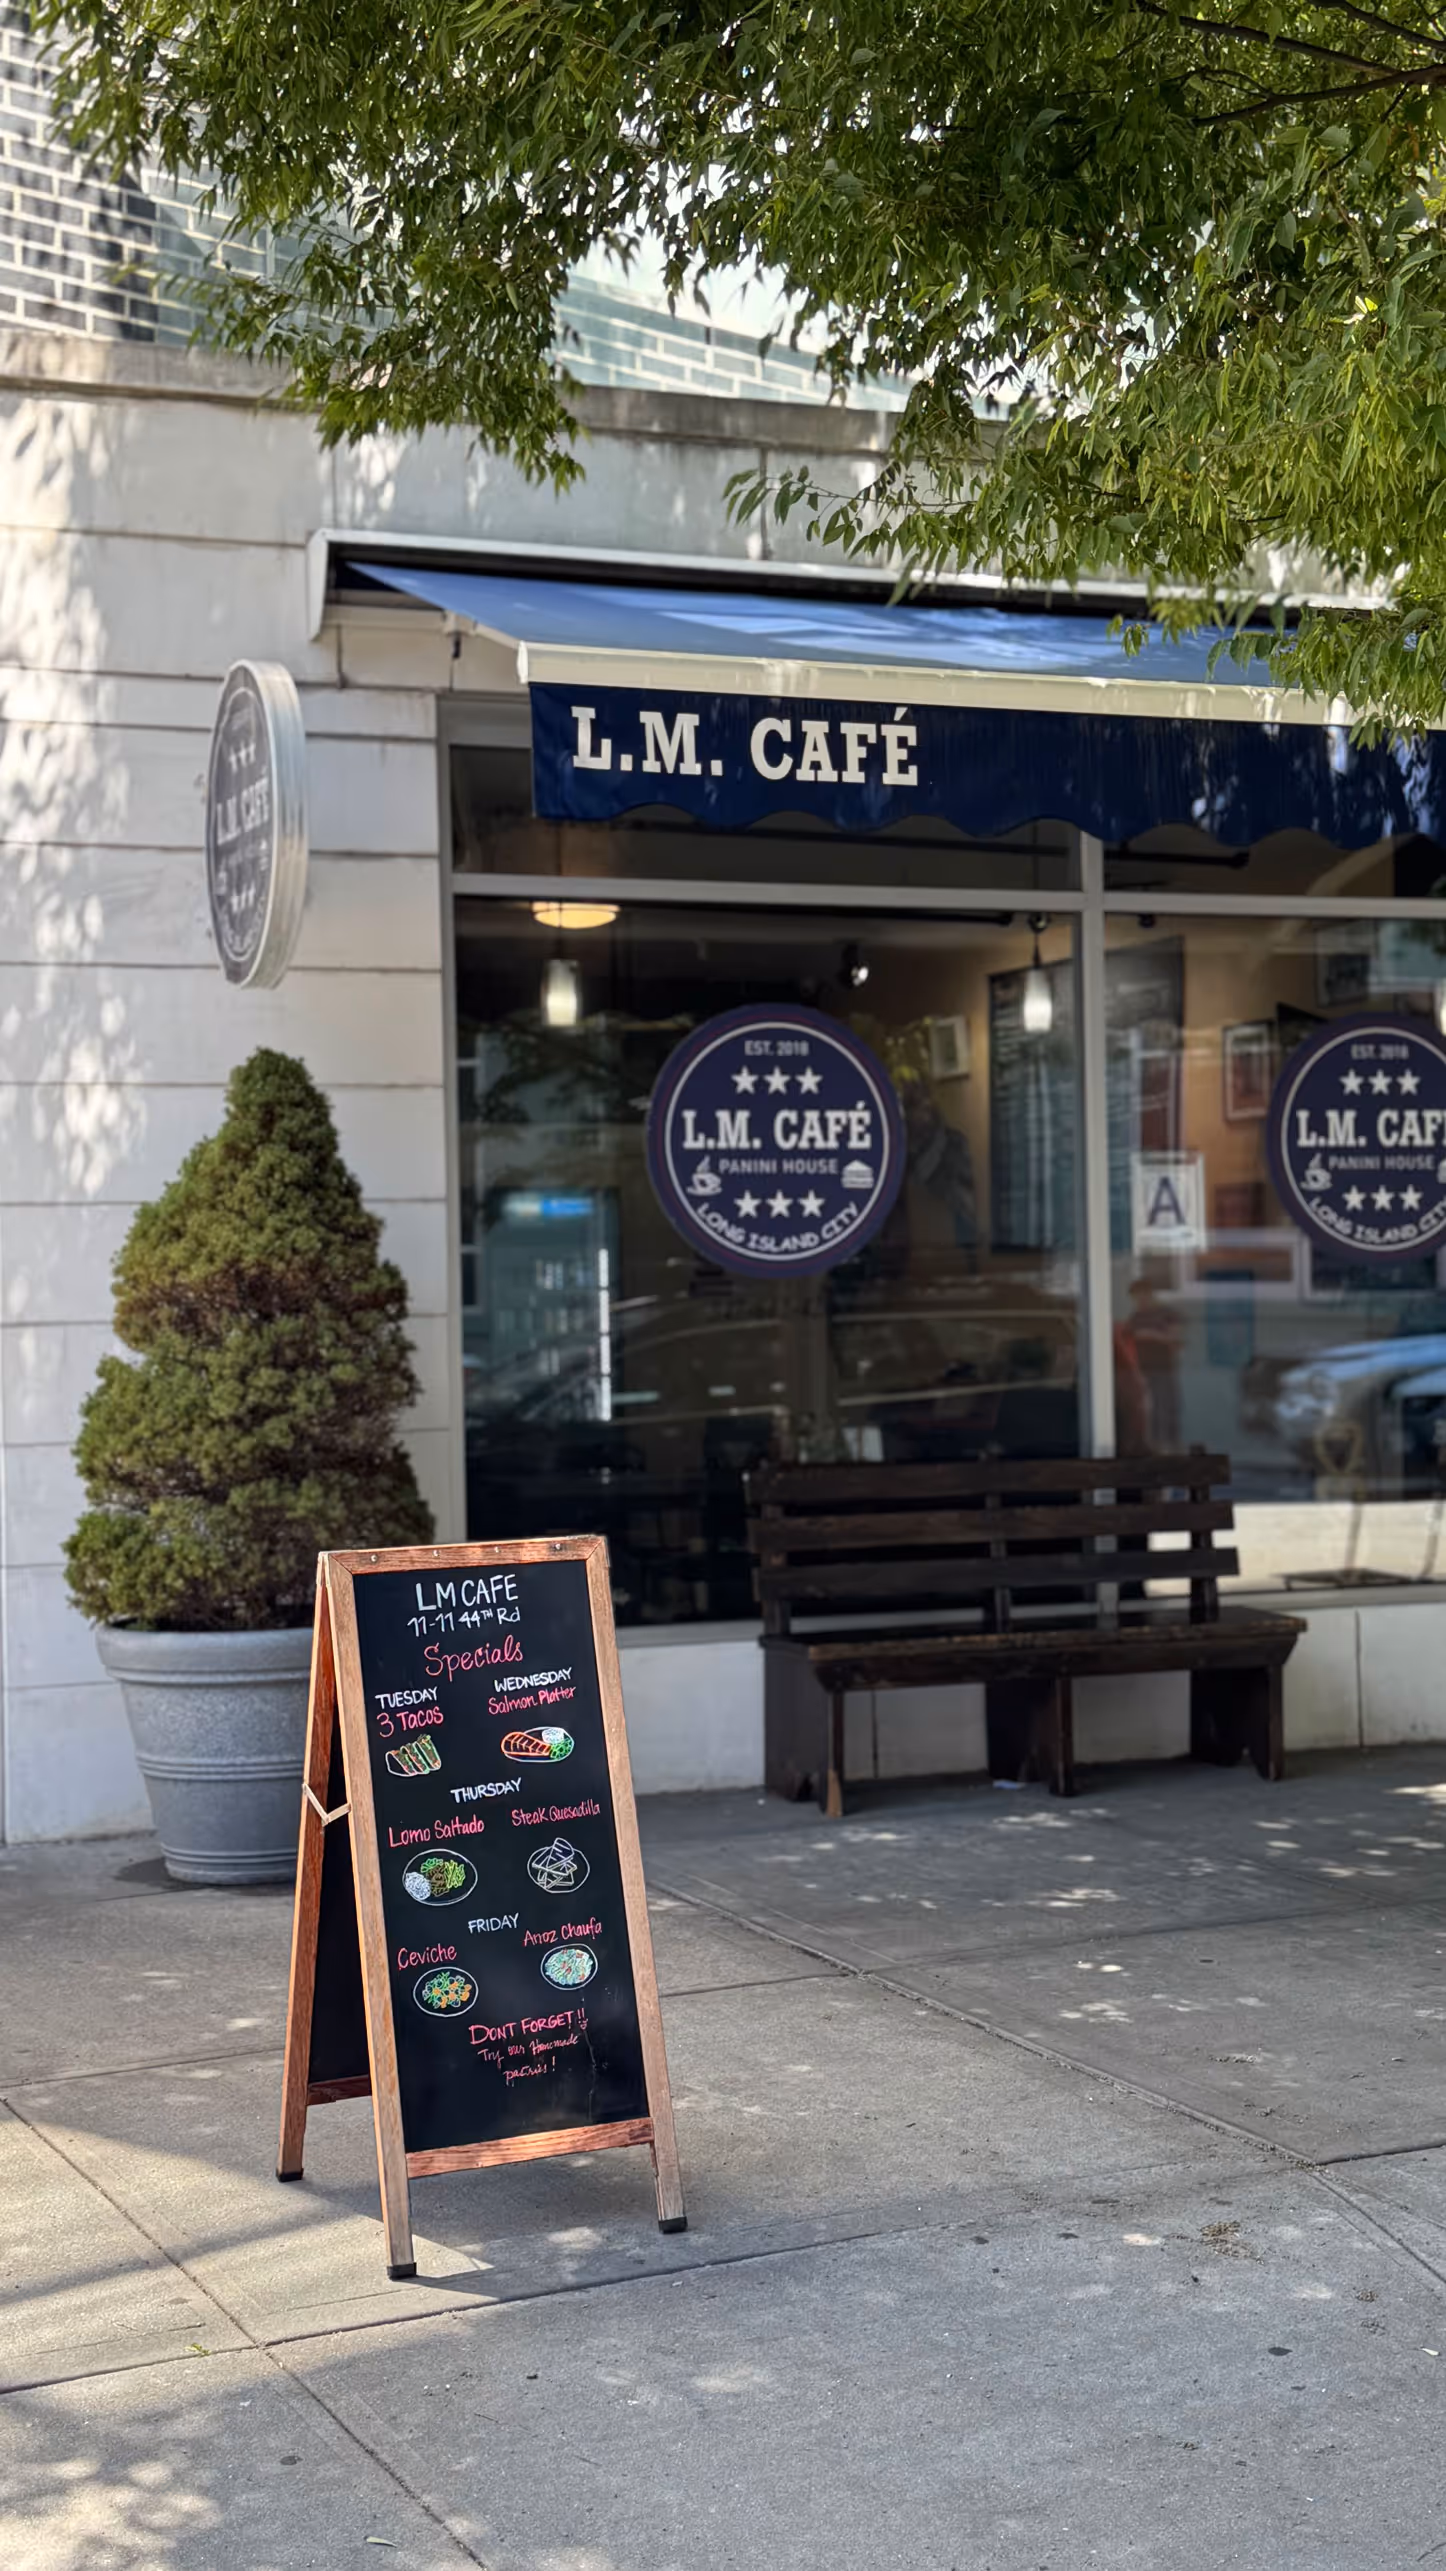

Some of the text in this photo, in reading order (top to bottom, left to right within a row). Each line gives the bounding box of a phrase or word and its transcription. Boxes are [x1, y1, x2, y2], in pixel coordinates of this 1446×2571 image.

[571, 706, 918, 786] L.M. CAFÉ
[744, 1040, 809, 1056] EST. 2018
[1351, 1044, 1377, 1060] EST.
[682, 1101, 872, 1150] L.M. CAFÉ
[1297, 1109, 1446, 1147] L.M. CAF
[718, 1158, 839, 1175] PANINI HOUSE
[1328, 1155, 1435, 1171] PANINI HOUSE
[1147, 1176, 1187, 1226] A
[697, 1202, 859, 1252] LONG ISLAND CITY
[1310, 1196, 1353, 1235] LONG
[1354, 1223, 1418, 1244] ISLAND
[415, 1573, 519, 1611] LM CAFE
[406, 1611, 455, 1637] 11-11
[496, 1606, 521, 1625] Rd
[423, 1634, 524, 1682] Specials
[494, 1667, 572, 1693] WEDNESDAY
[375, 1686, 438, 1710] TUESDAY
[488, 1695, 536, 1715] Salmon
[376, 1712, 395, 1738] 3
[450, 1777, 522, 1803] THURSDAY
[549, 1798, 601, 1822] Quesadilla
[388, 1813, 485, 1848] Lomo Saltado
[468, 1912, 519, 1934] FRIDAY
[396, 1942, 457, 1971] Ceviche
[477, 2048, 505, 2069] Try
